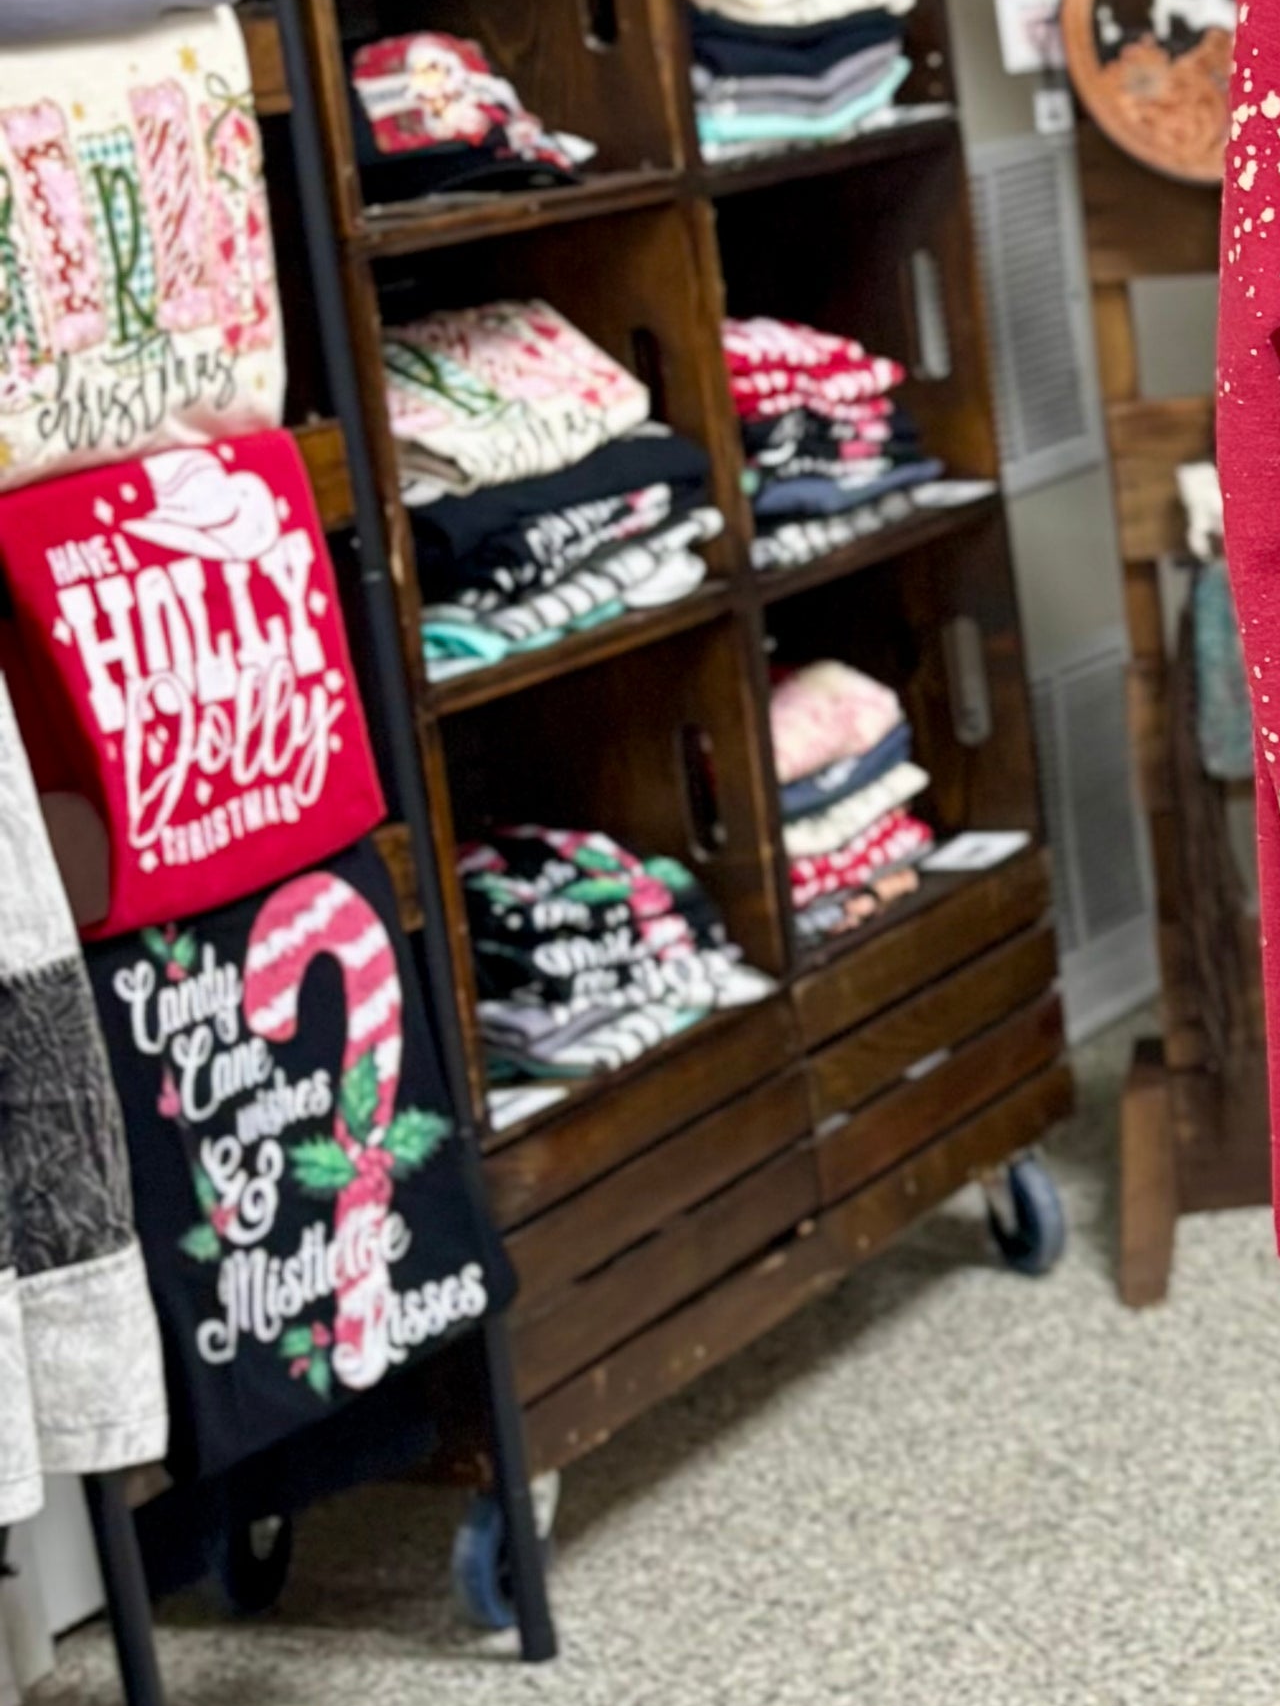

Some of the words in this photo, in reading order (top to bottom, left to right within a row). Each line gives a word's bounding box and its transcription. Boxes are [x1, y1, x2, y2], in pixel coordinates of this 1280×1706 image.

[45, 533, 118, 587] HAVE
[111, 532, 140, 573] A
[56, 529, 326, 733] HOLLY
[159, 782, 301, 866] CHRISTMAS
[113, 942, 243, 1055] Candy
[171, 1024, 274, 1122] Cane
